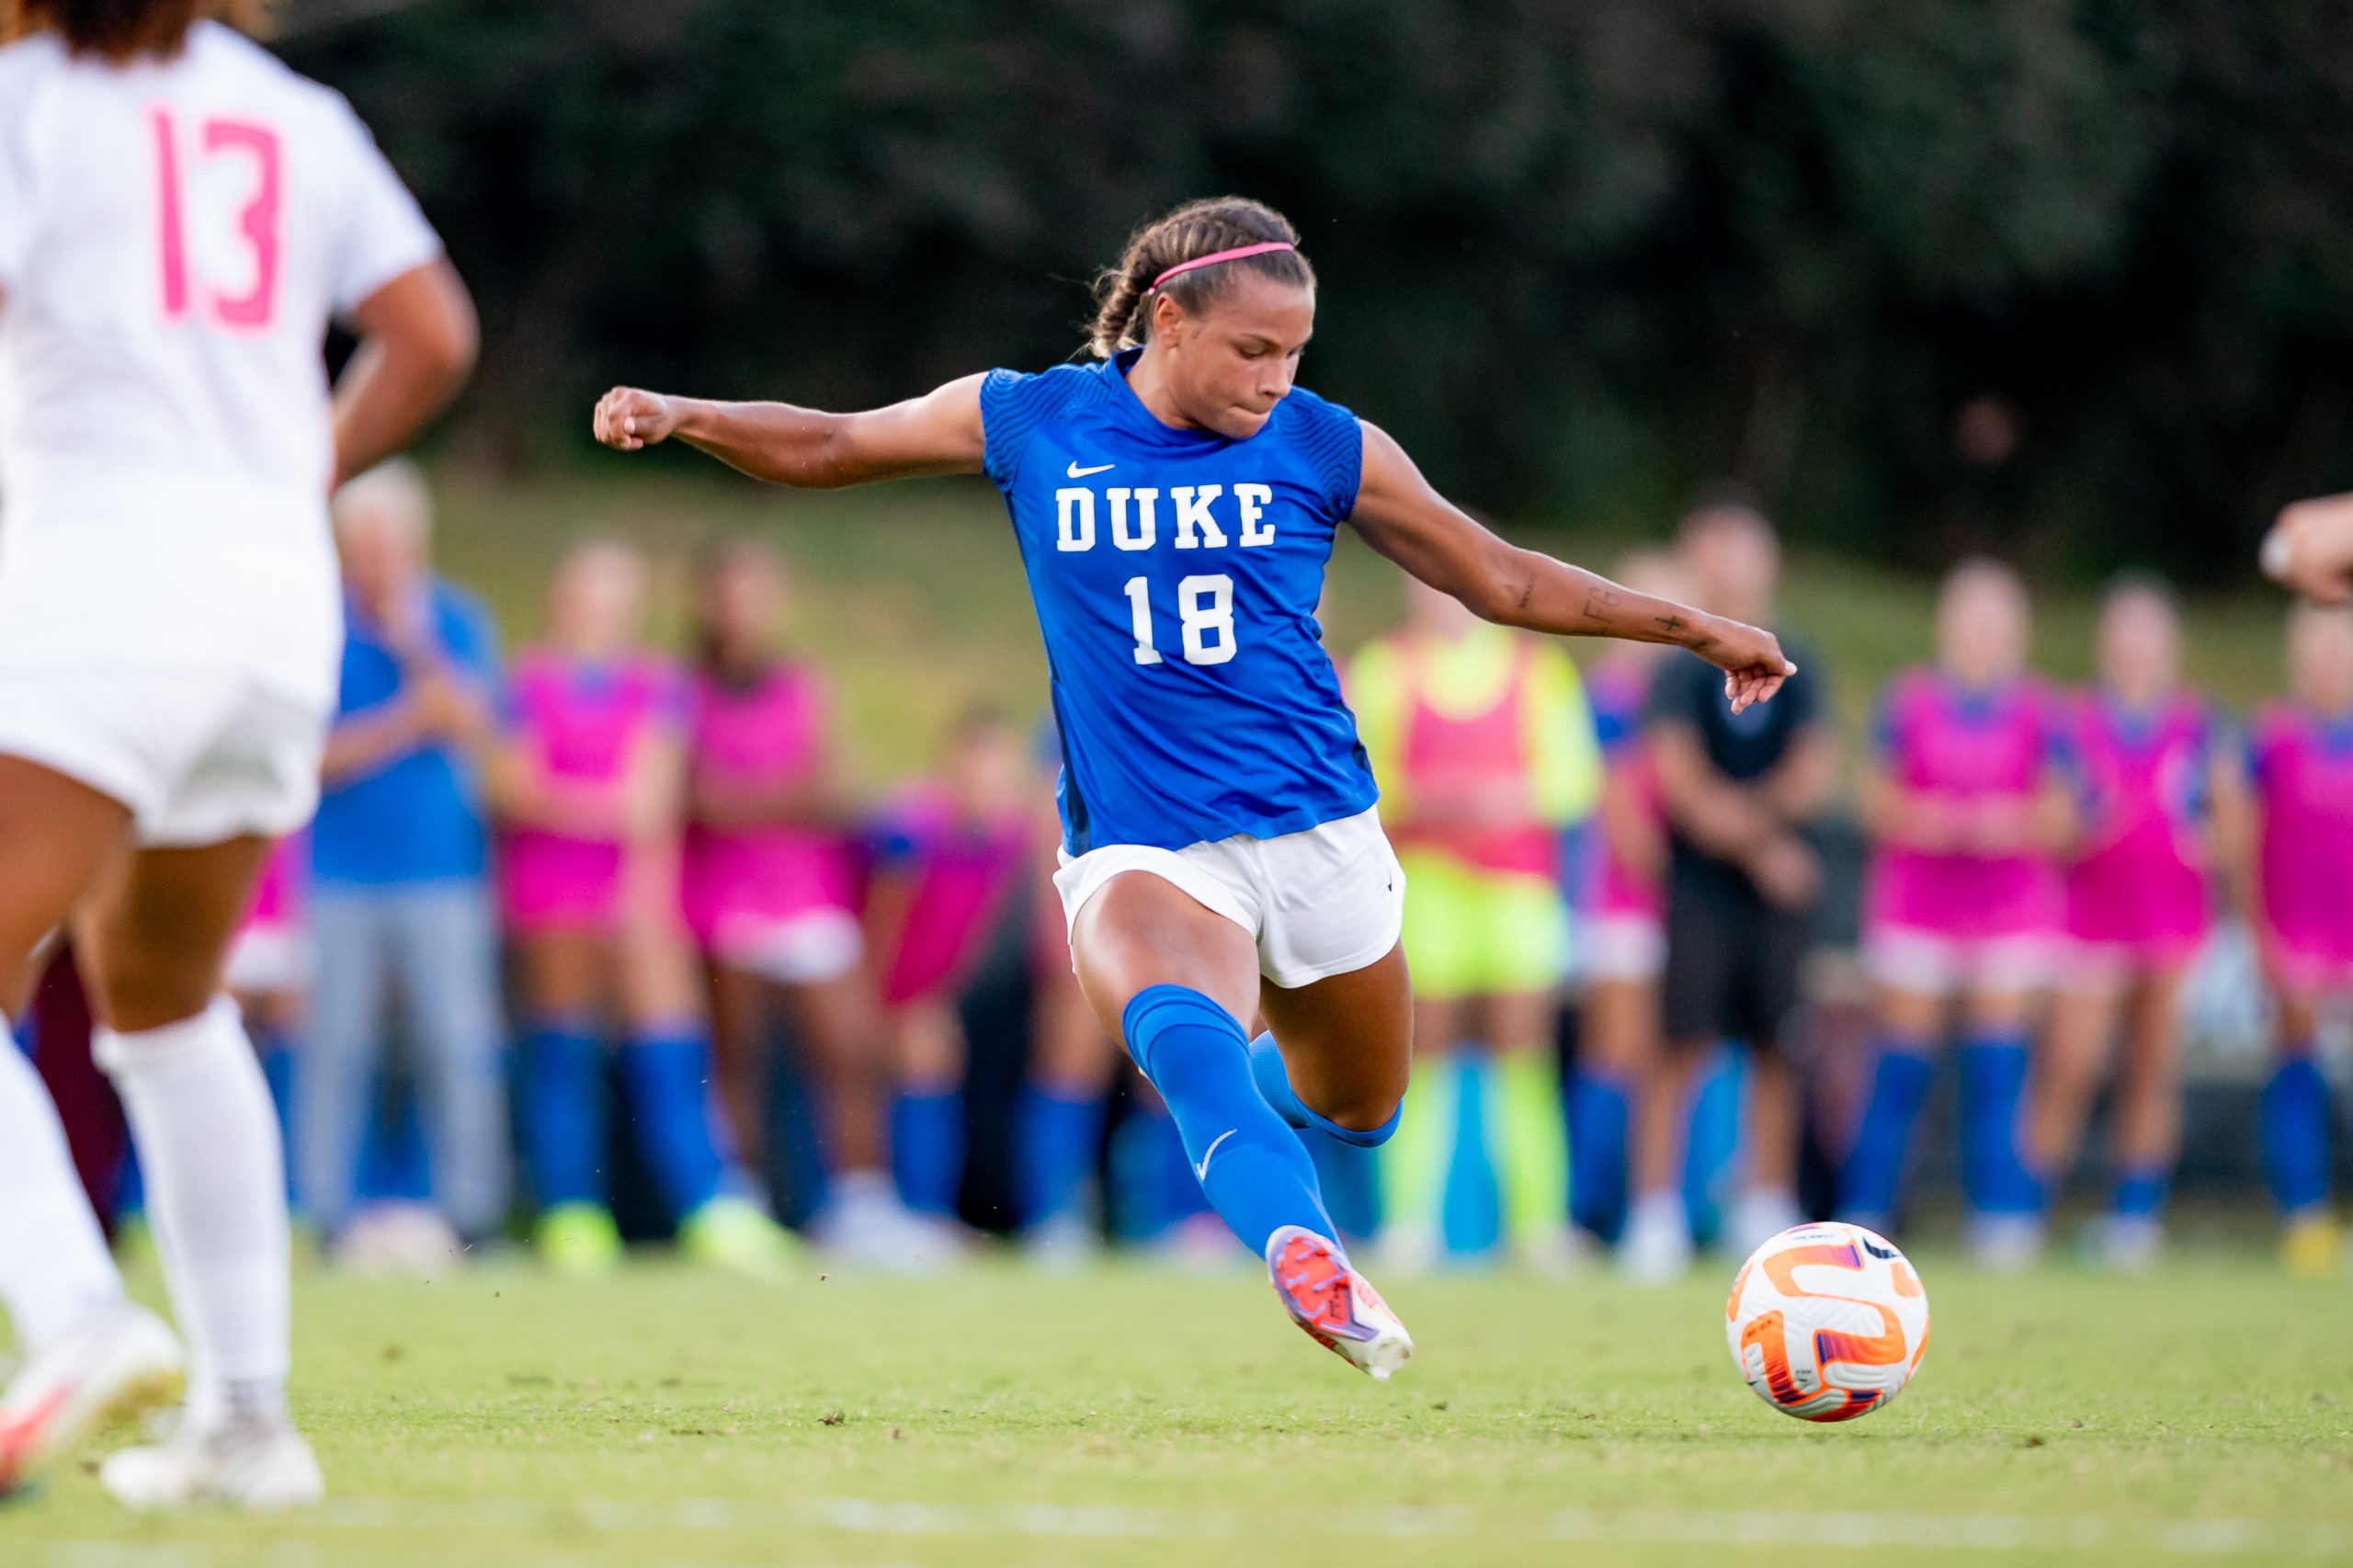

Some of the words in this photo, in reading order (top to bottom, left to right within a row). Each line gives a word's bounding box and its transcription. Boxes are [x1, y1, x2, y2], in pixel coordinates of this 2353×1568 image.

[149, 108, 283, 332] 13
[1055, 483, 1276, 551] DUKE
[1123, 574, 1237, 665] 18
